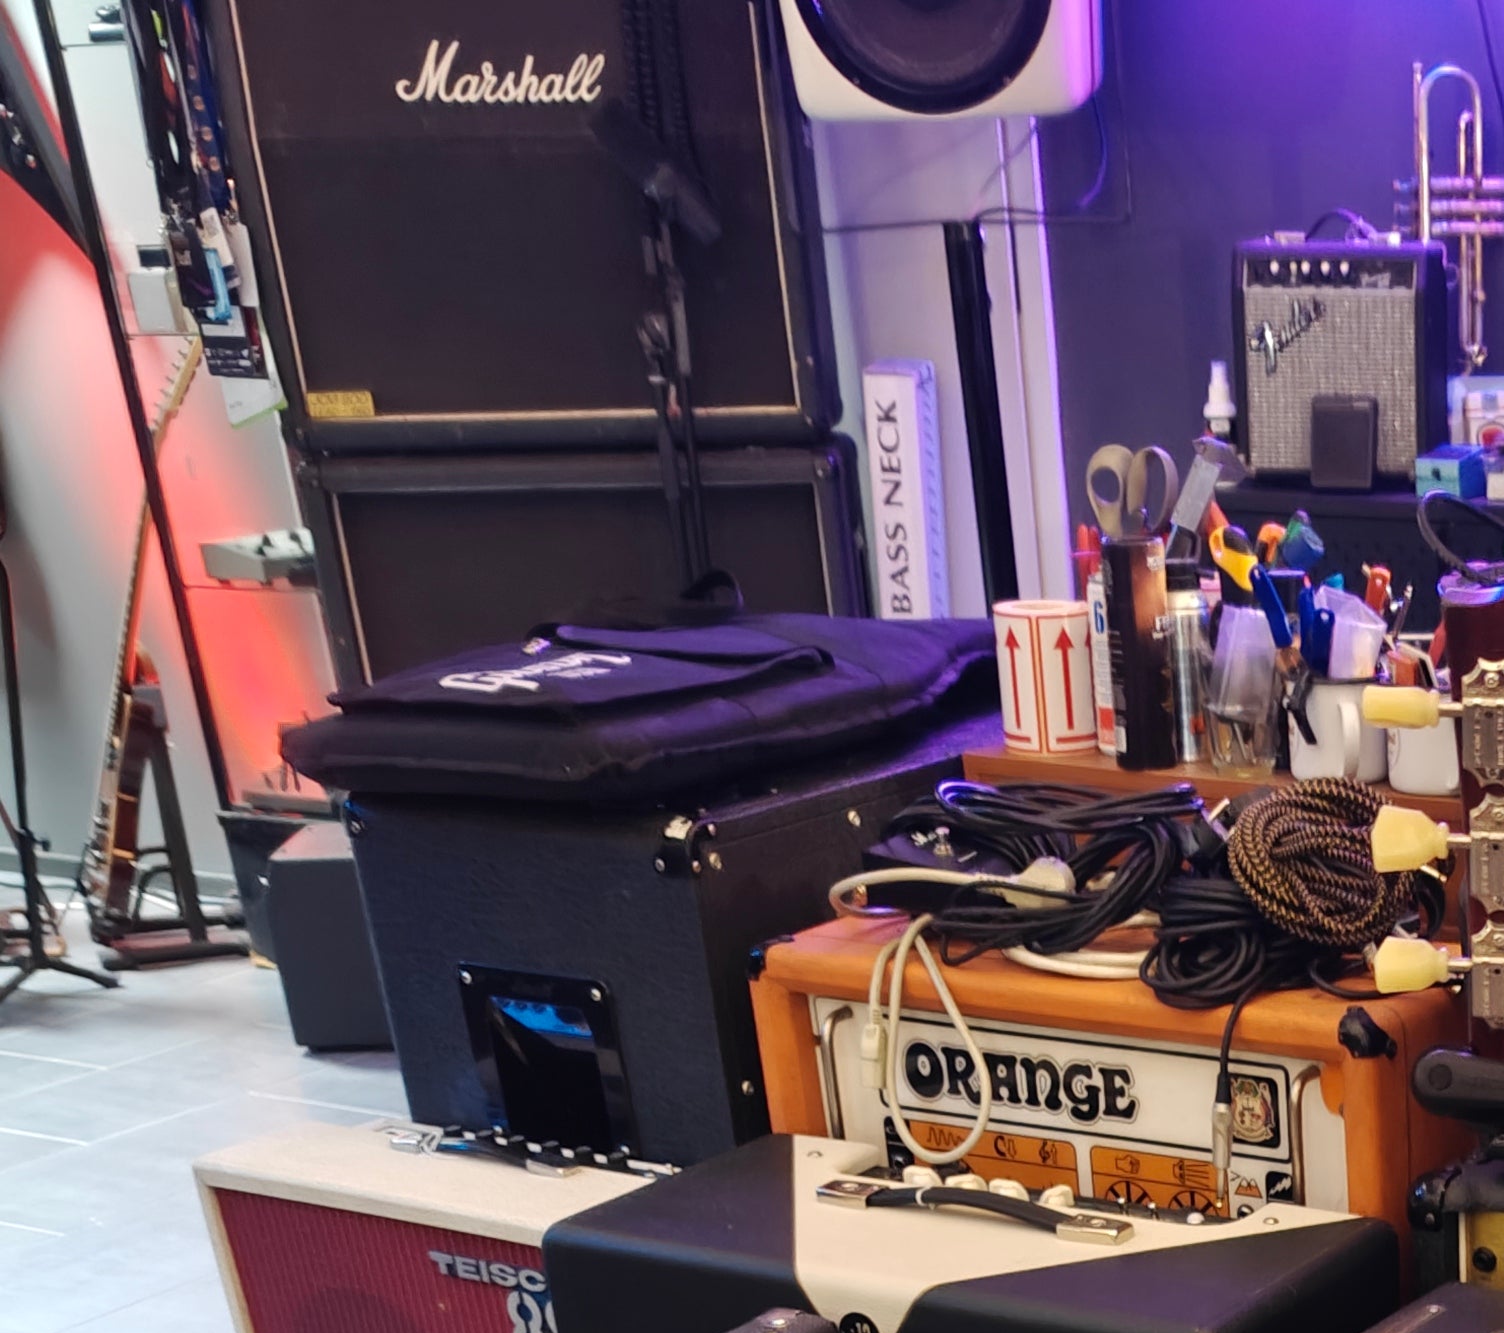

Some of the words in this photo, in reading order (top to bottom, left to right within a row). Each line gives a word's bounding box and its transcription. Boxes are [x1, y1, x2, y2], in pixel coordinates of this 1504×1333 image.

[395, 39, 605, 103] Marshall
[875, 399, 904, 508] NECK
[885, 523, 913, 615] BASS
[904, 1040, 1139, 1124] ORANGE
